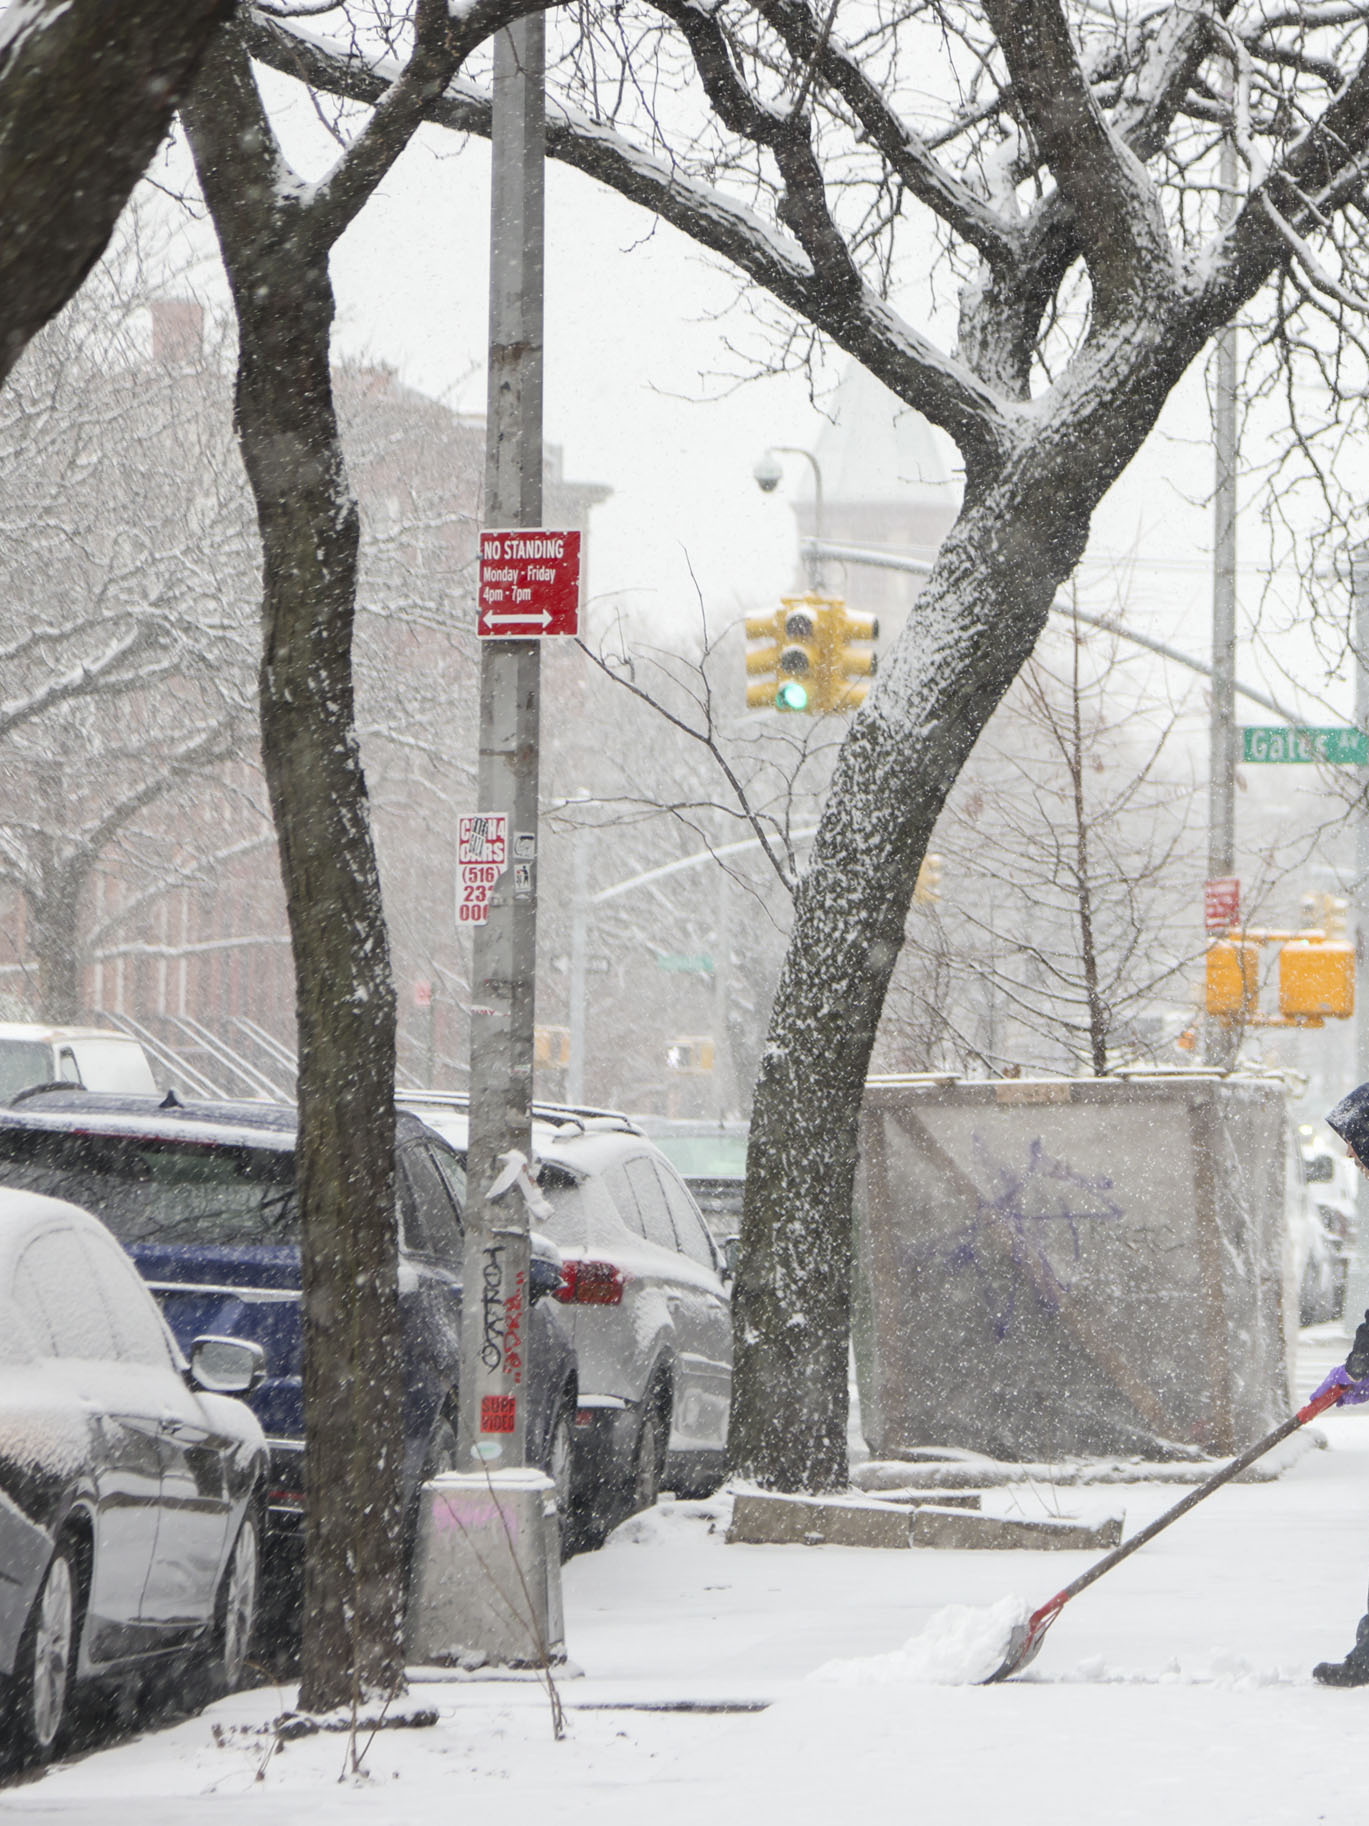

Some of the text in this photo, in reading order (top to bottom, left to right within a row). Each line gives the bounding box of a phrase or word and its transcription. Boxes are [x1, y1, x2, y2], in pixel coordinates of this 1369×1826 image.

[483, 539, 564, 560] NO STANDING
[483, 565, 519, 585] Monday
[526, 564, 556, 585] Friday
[482, 586, 503, 605] 4pm
[511, 585, 532, 604] 7pm
[462, 865, 501, 884] (516)
[463, 885, 495, 903] 23
